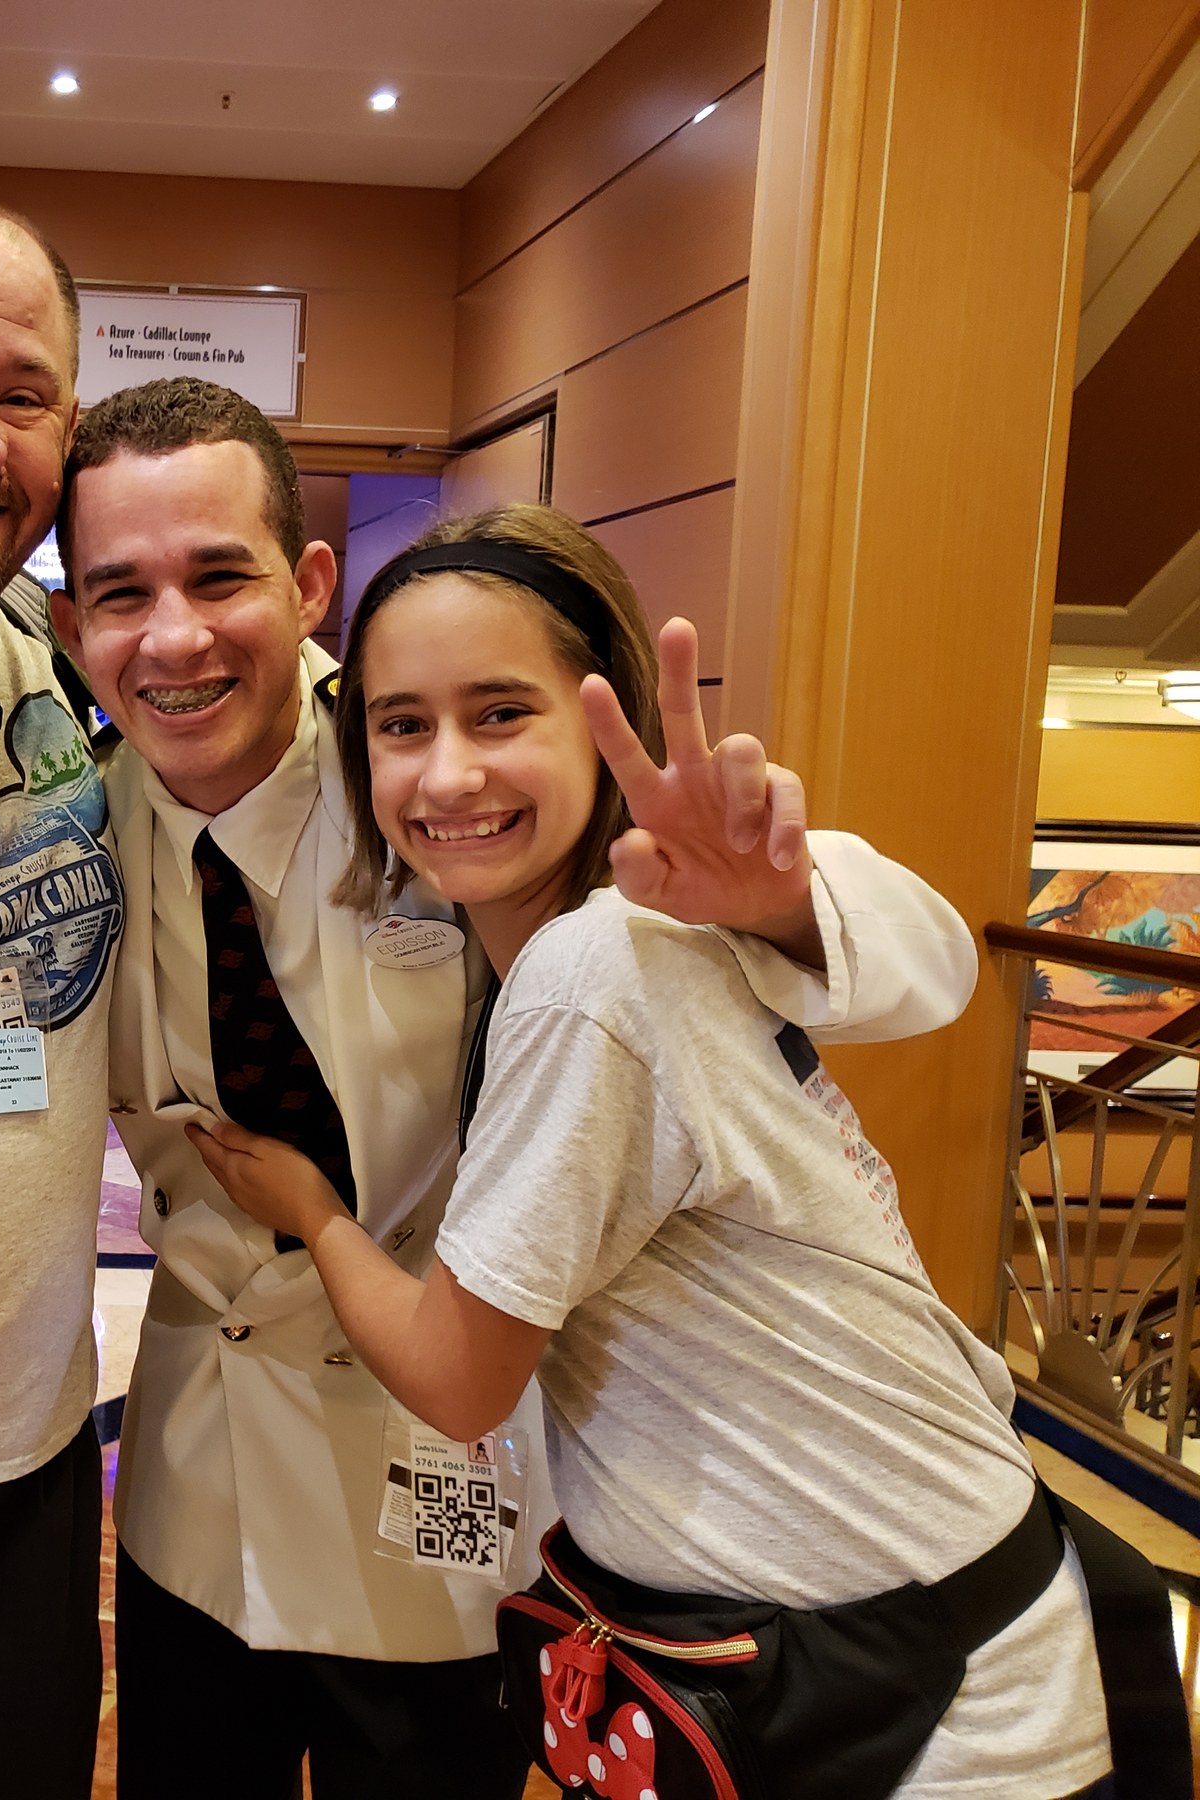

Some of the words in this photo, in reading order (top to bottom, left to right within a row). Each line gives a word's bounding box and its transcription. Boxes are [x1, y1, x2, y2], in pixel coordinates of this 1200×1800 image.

[110, 324, 135, 339] Azure
[143, 325, 177, 341] Cadillac
[179, 327, 211, 345] Lounge
[109, 343, 123, 358] Sea
[126, 344, 165, 360] Treasures
[173, 346, 201, 362] Crown
[202, 350, 210, 362] &
[212, 348, 226, 363] Fin
[227, 349, 245, 364] Pub
[41, 861, 112, 917] CANAL
[376, 929, 447, 956] EDDISSON
[65, 980, 81, 1002] 2018
[414, 1457, 439, 1469] 5761
[441, 1460, 466, 1472] 4065
[468, 1464, 492, 1476] 3501
